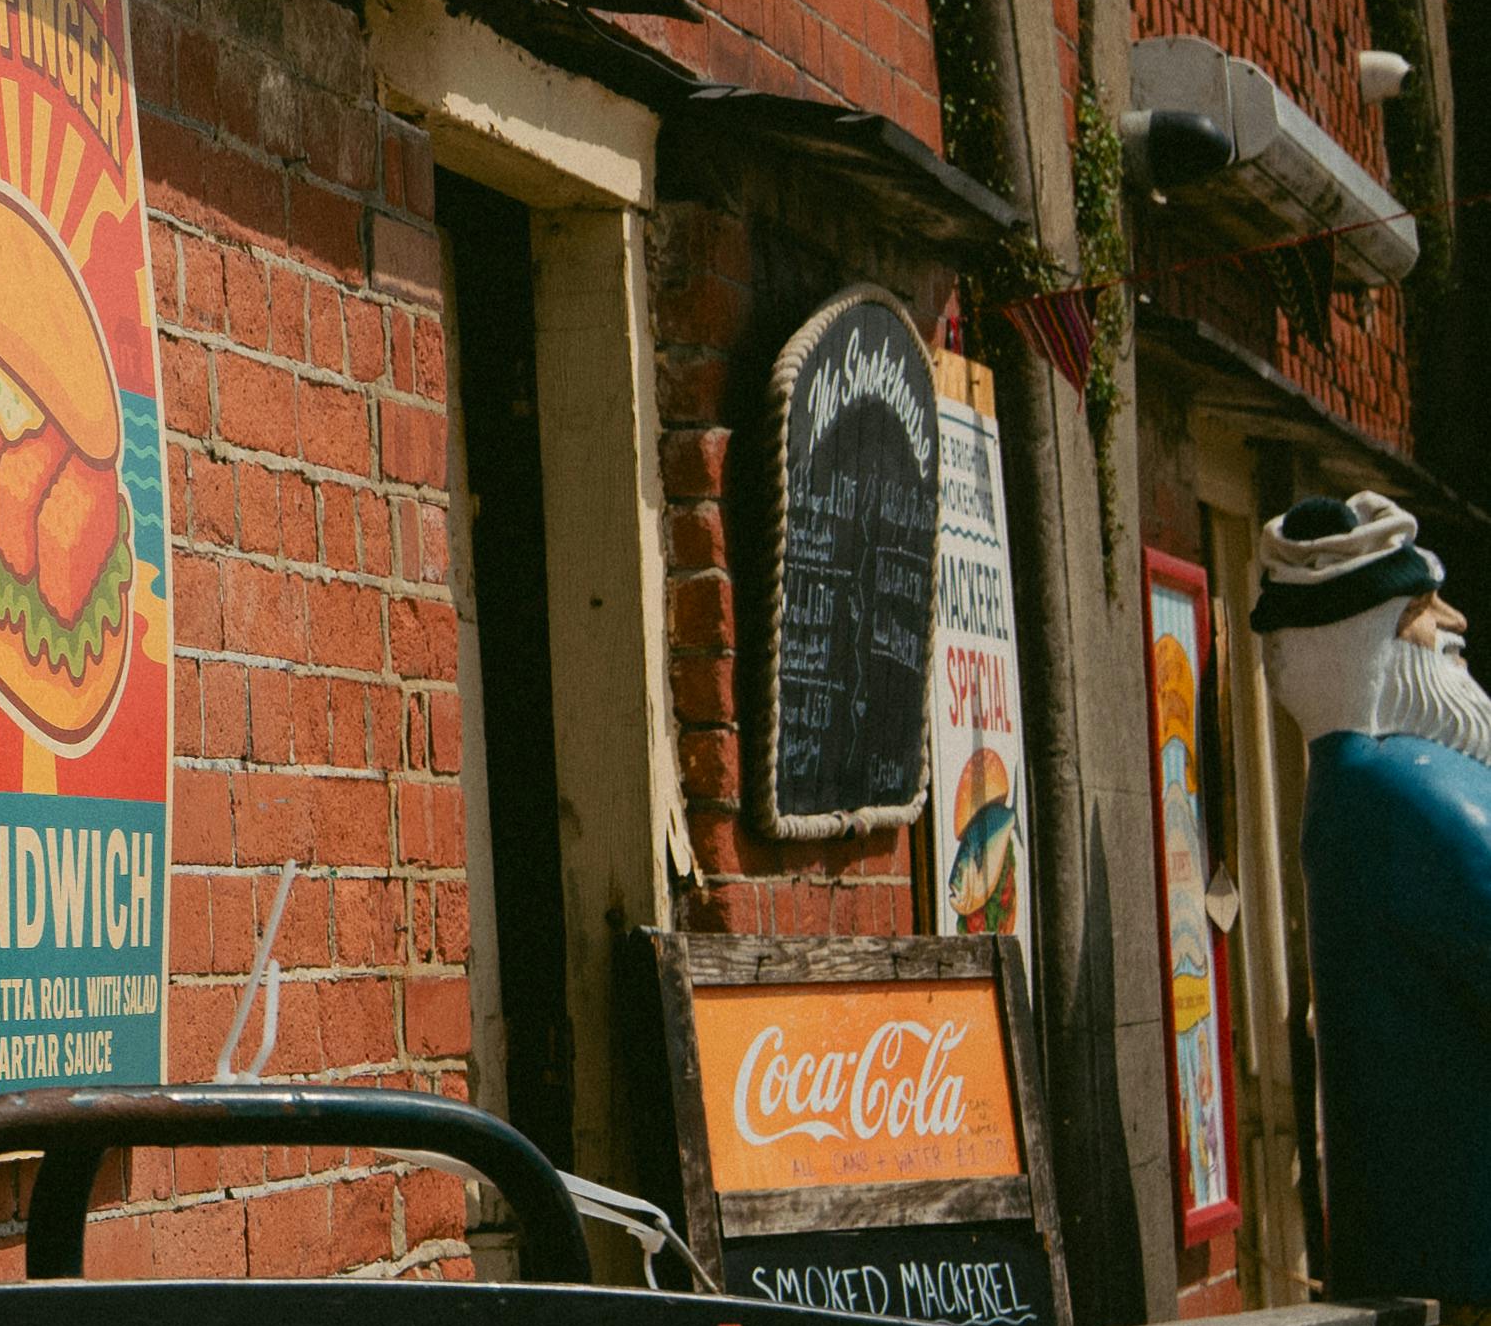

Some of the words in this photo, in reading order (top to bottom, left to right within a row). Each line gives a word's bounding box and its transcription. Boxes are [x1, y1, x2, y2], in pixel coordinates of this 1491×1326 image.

[808, 357, 840, 455] The
[841, 327, 931, 479] Smokehouse
[940, 477, 997, 527] MOKEHOUSE
[937, 553, 1008, 641] MACKEREL
[947, 644, 1012, 733] SPECIAL
[40, 976, 83, 1021] ROLL
[86, 975, 121, 1017] WITH
[123, 974, 158, 1015] SALAD
[64, 1030, 113, 1076] SAUCE
[733, 1019, 971, 1146] Coca-Cola
[752, 1266, 888, 1316] SMOKED
[900, 1261, 1031, 1320] MACKEREL
